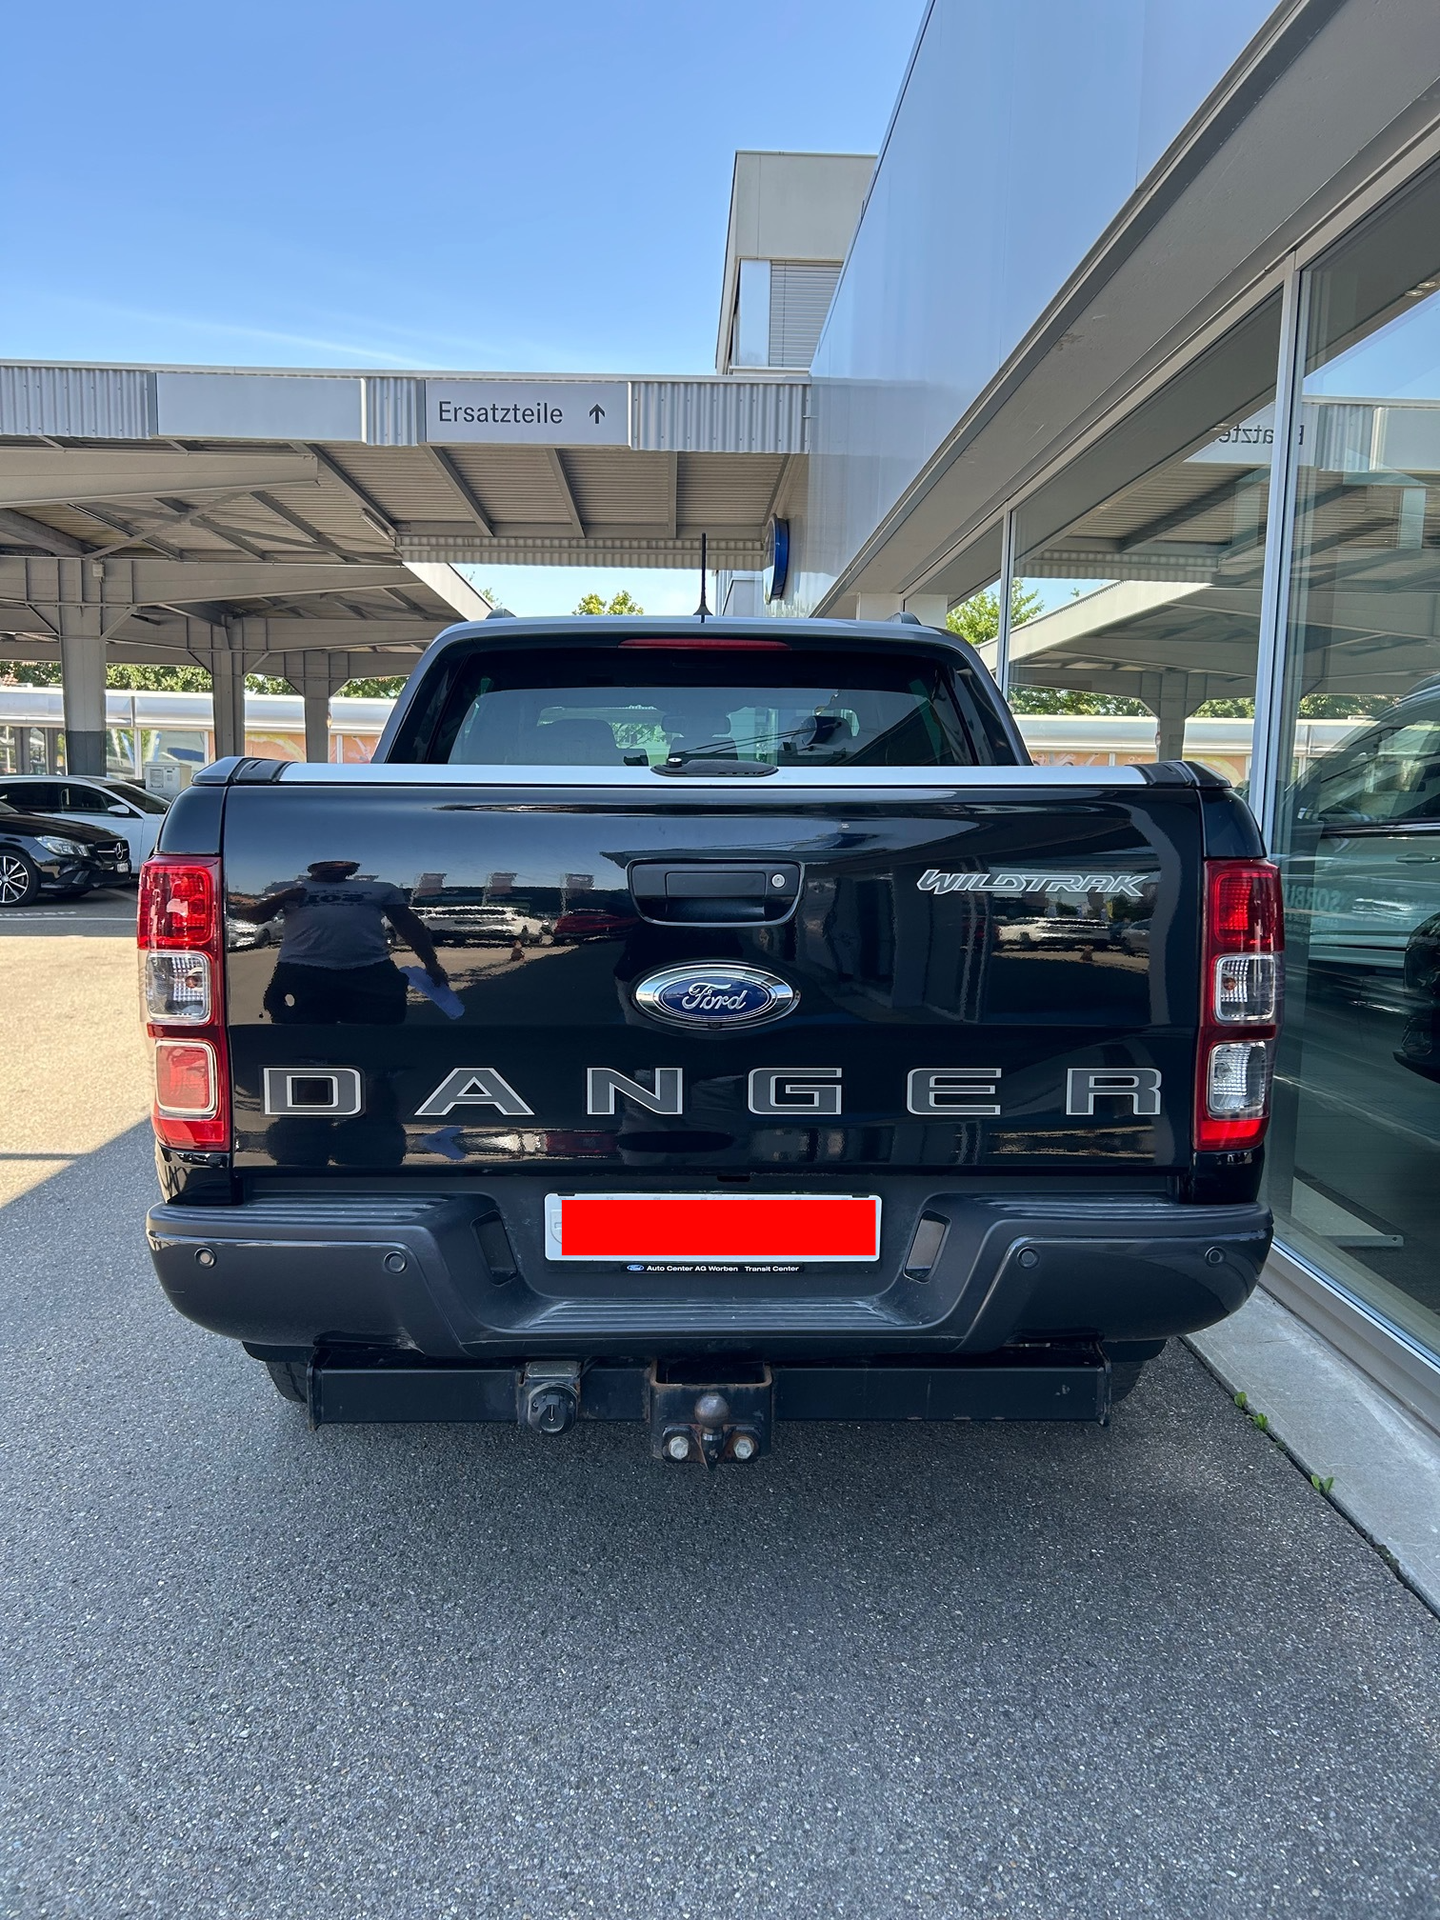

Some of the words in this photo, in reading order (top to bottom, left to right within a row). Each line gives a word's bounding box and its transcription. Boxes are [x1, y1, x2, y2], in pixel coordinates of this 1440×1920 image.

[439, 401, 563, 423] Ersatzteile
[916, 869, 1151, 897] WILDTRAK
[681, 982, 748, 1010] Ford
[263, 1067, 1162, 1116] DANGER
